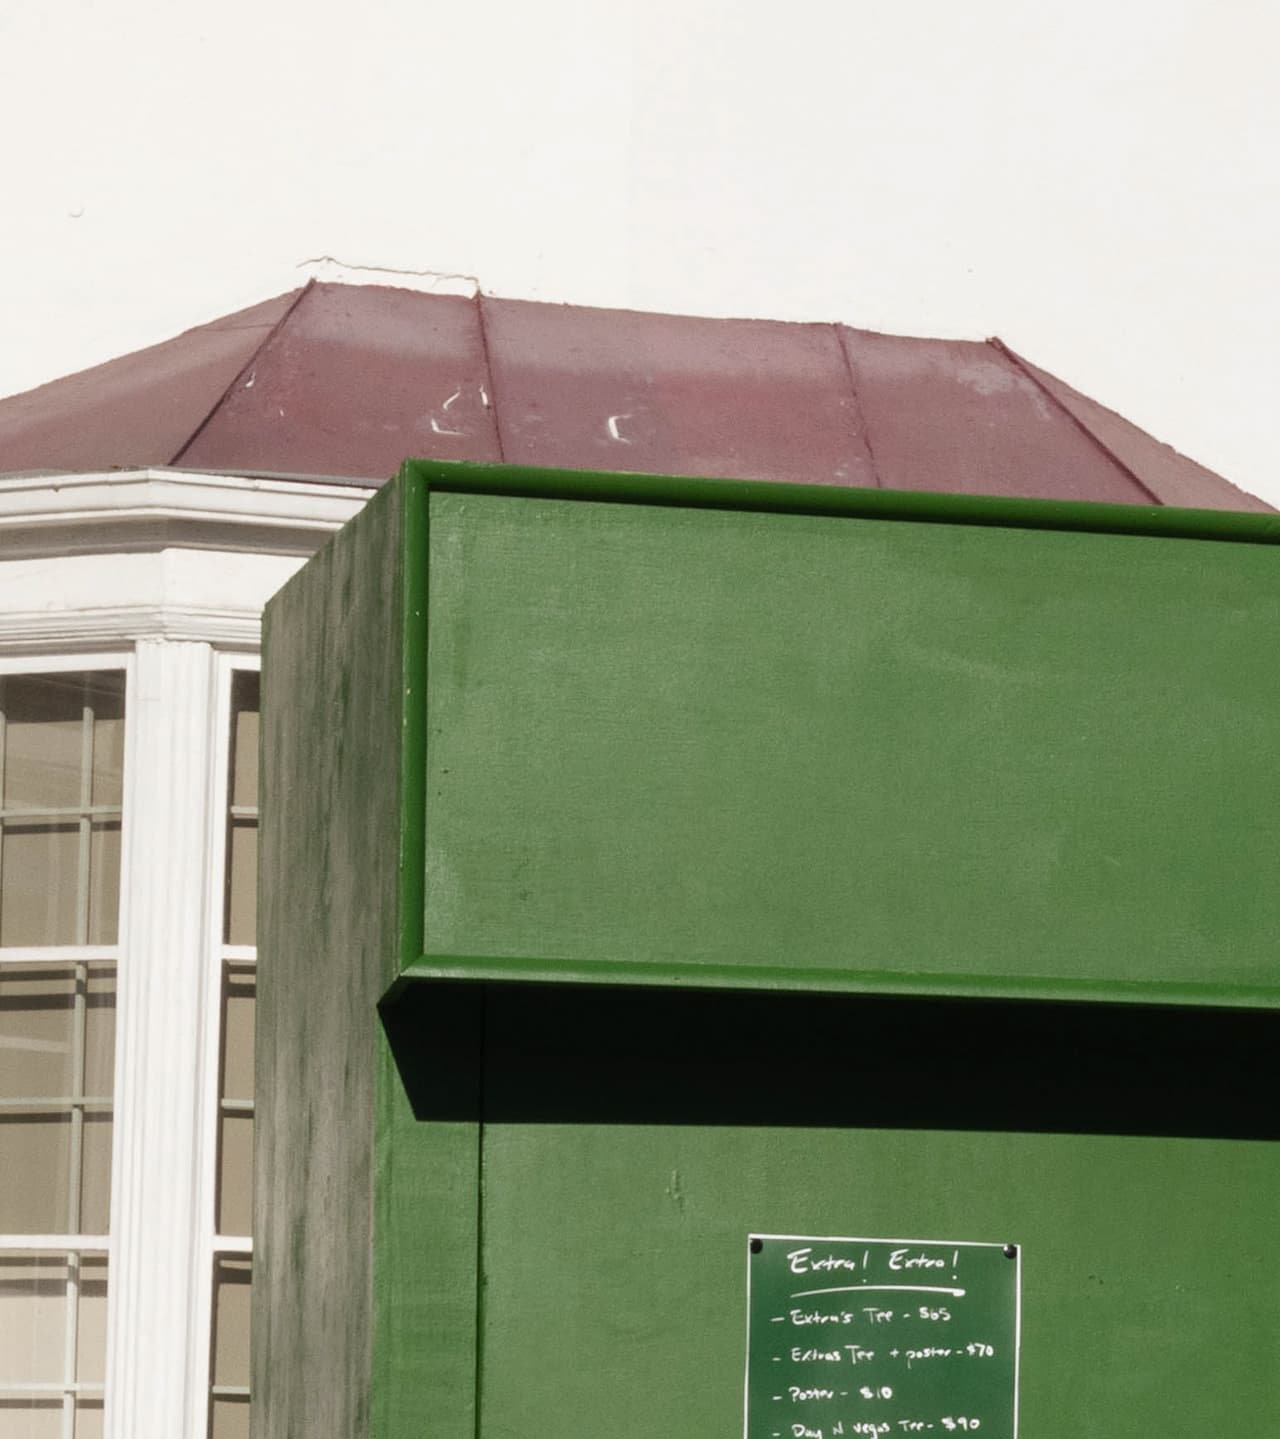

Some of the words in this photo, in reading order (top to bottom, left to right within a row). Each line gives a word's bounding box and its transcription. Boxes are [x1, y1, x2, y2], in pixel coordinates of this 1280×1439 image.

[863, 1307, 893, 1324] Tee
[919, 1307, 951, 1322] $65
[845, 1344, 875, 1364] Tee
[966, 1342, 994, 1357] $70
[859, 1386, 893, 1400] $10
[941, 1417, 980, 1431] $90
